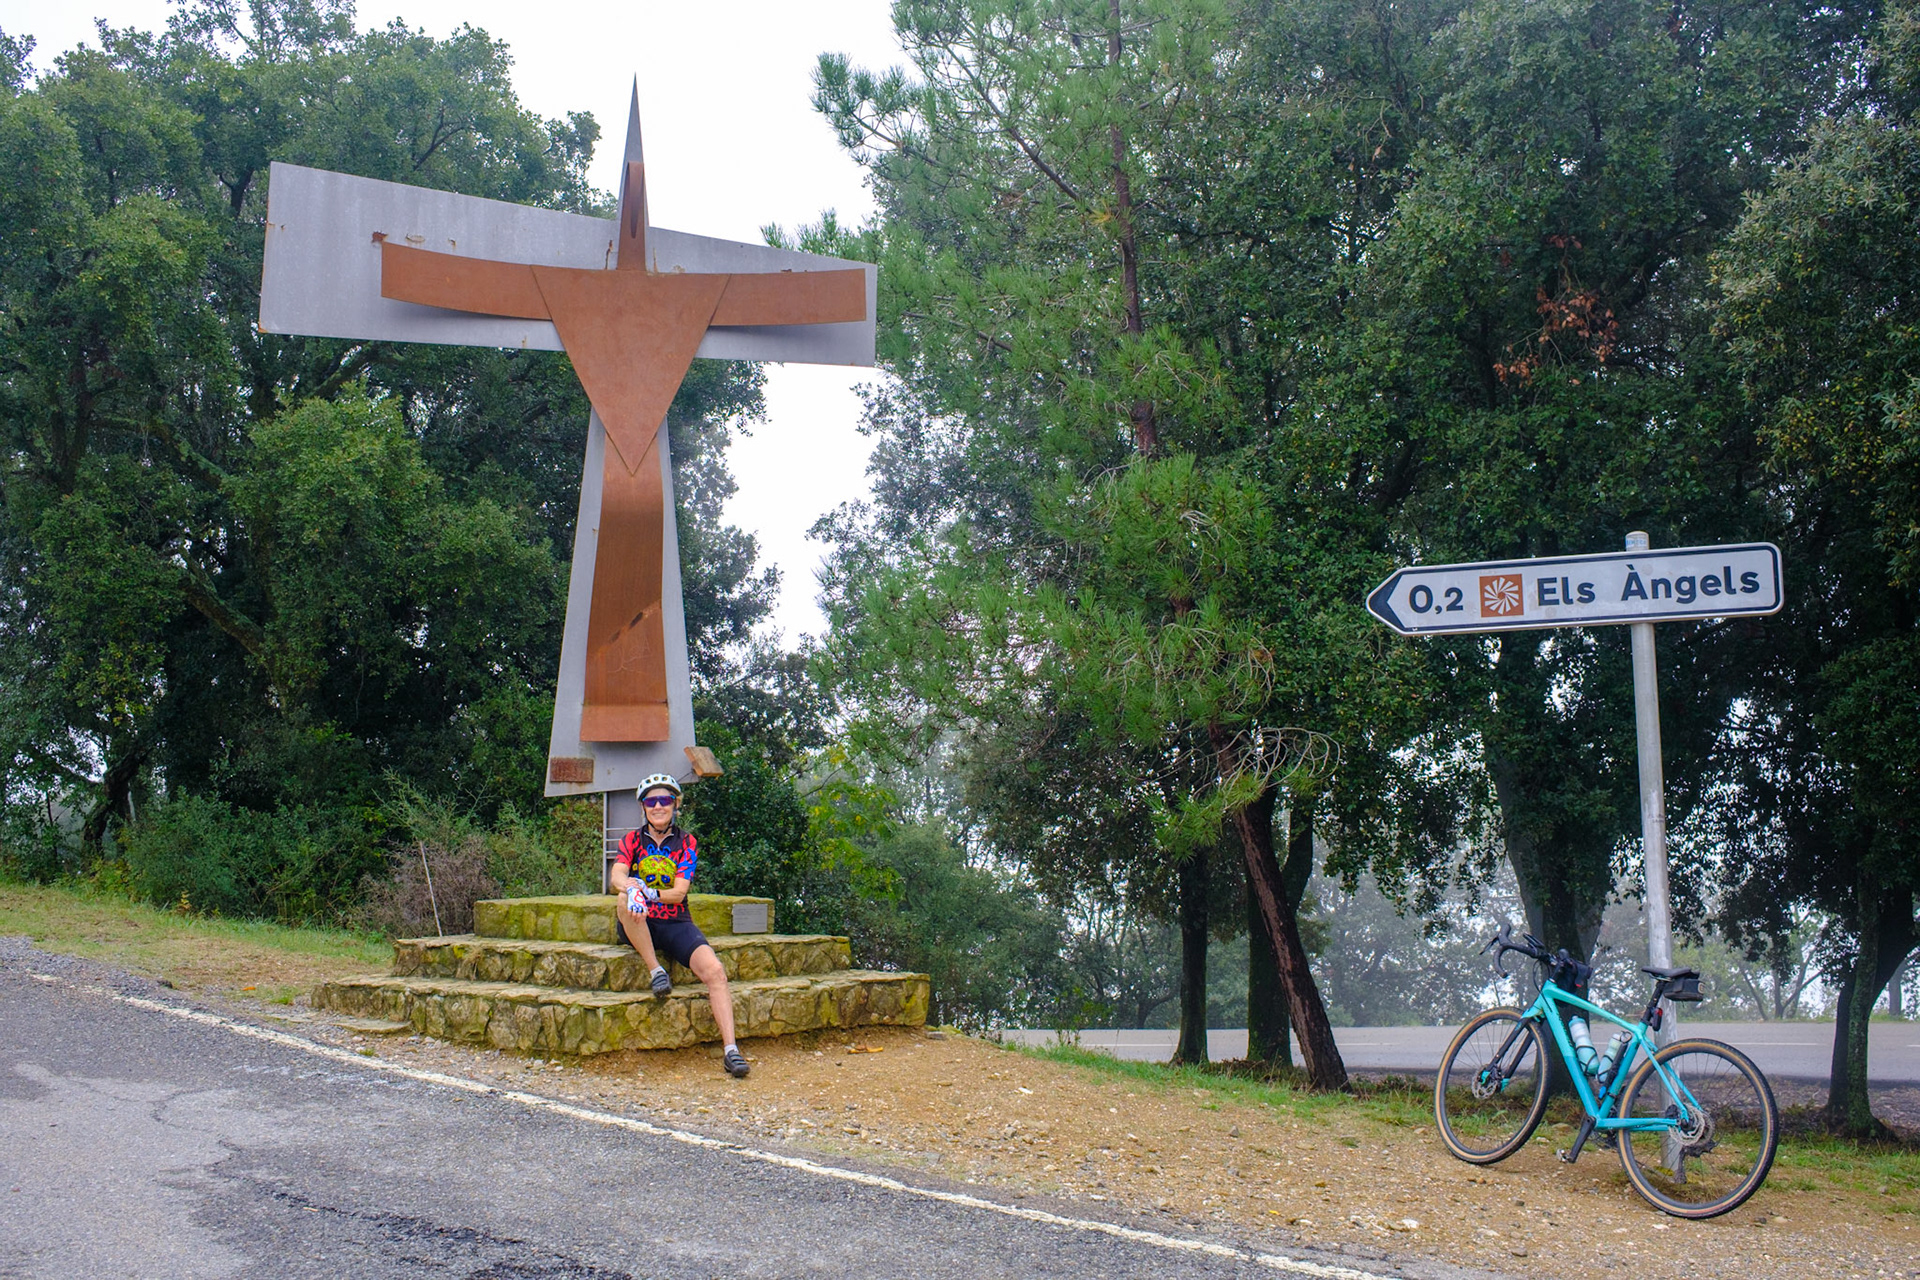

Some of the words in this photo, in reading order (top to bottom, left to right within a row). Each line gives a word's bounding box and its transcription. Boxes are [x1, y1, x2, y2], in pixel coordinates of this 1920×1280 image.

[1409, 585, 1463, 614] 0,2
[1537, 577, 1596, 606] Els
[1621, 564, 1760, 604] Àngels
